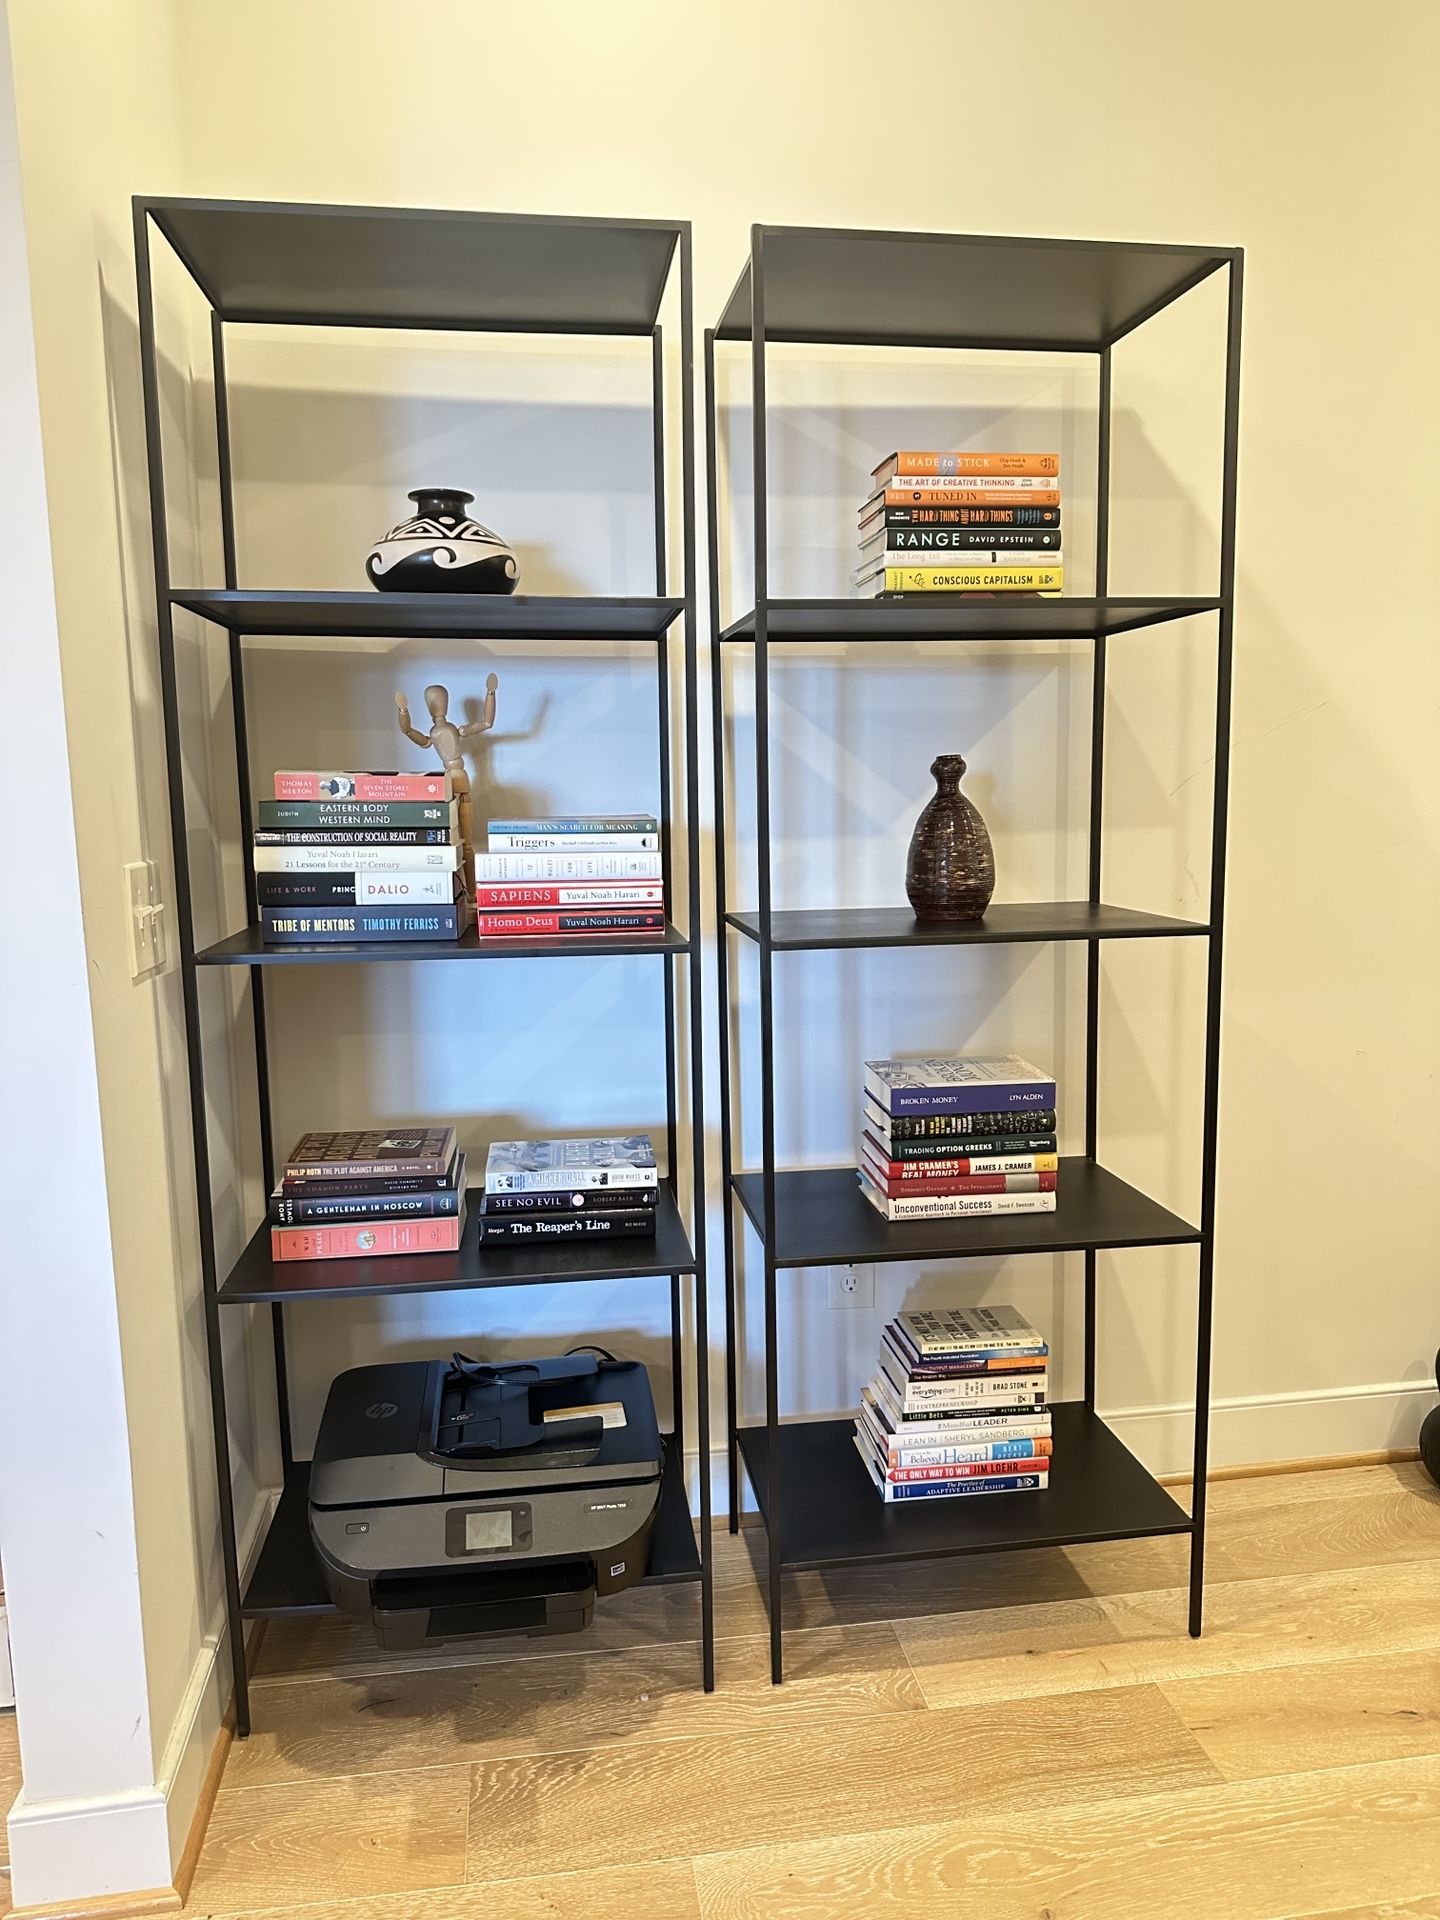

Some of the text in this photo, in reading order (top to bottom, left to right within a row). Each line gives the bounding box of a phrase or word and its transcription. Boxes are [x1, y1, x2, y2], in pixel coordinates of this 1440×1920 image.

[907, 457, 990, 467] MADE to STICK
[980, 479, 1015, 487] THINKING
[929, 492, 964, 501] TUNED
[967, 492, 977, 501] IN
[919, 509, 938, 522] HARD
[939, 509, 959, 522] THING
[970, 509, 989, 522] HARD
[990, 510, 1013, 522] THINGS
[896, 533, 960, 546] RANGE
[907, 552, 926, 561] Long
[933, 575, 1033, 585] CONSCIOUS CAPITALISM
[363, 805, 389, 813] BODY
[319, 816, 391, 824] WESTERN MIND
[287, 833, 301, 842] THE
[301, 833, 353, 842] CONSTRUCTION
[355, 832, 417, 842] OF SOCIAL REALITY
[507, 836, 555, 850] Triggers
[368, 861, 400, 870] Century
[368, 885, 409, 894] DALIO
[490, 890, 551, 901] SAPIENS
[566, 892, 588, 900] Yuval
[590, 891, 612, 899] Noah
[272, 918, 439, 932] TRIBE OF MENTORS TIMOTHY FERRISS
[487, 917, 639, 928] Homo Deus Yuval Noah Harari
[900, 1097, 930, 1105] BROKEN
[932, 1096, 958, 1104] MONEY
[904, 1144, 993, 1155] TRADING OPTION GREEKS
[287, 1168, 306, 1177] PHILIP
[306, 1167, 322, 1176] ROTH
[322, 1167, 333, 1175] THE
[349, 1166, 372, 1174] AGAINST
[373, 1165, 398, 1173] AMERICA
[902, 1160, 959, 1172] JIM CRAMER'S
[975, 1164, 997, 1172] JAMES
[1004, 1162, 1032, 1170] CRAMER
[528, 1174, 533, 1184] A
[536, 1172, 564, 1184] HIGHER
[566, 1171, 585, 1182] CALL
[307, 1201, 423, 1215] A GENTLEMAN IN MOSCOW
[495, 1197, 562, 1208] SEE NO EVIL
[894, 1201, 957, 1214] Unconventional
[959, 1200, 992, 1209] Success
[511, 1223, 532, 1234] The
[535, 1220, 582, 1234] Reaper's
[585, 1220, 611, 1230] Line
[993, 1383, 1009, 1391] BRAD
[942, 1422, 971, 1430] Mindful
[973, 1418, 1008, 1427] LEADER
[944, 1433, 976, 1443] SHERYL
[979, 1429, 1025, 1439] SANDBERG
[1003, 1445, 1023, 1453] BERT
[910, 1446, 989, 1464] Believed Heard
[894, 1471, 909, 1480] THE
[909, 1470, 928, 1479] ONLY
[929, 1469, 945, 1478] WAY
[945, 1468, 955, 1477] TO
[955, 1467, 970, 1476] WIN
[970, 1465, 989, 1474] JIM
[991, 1463, 1019, 1473] LOEHR
[926, 1484, 1005, 1495] ADAPTIVE LEADERSHIP
